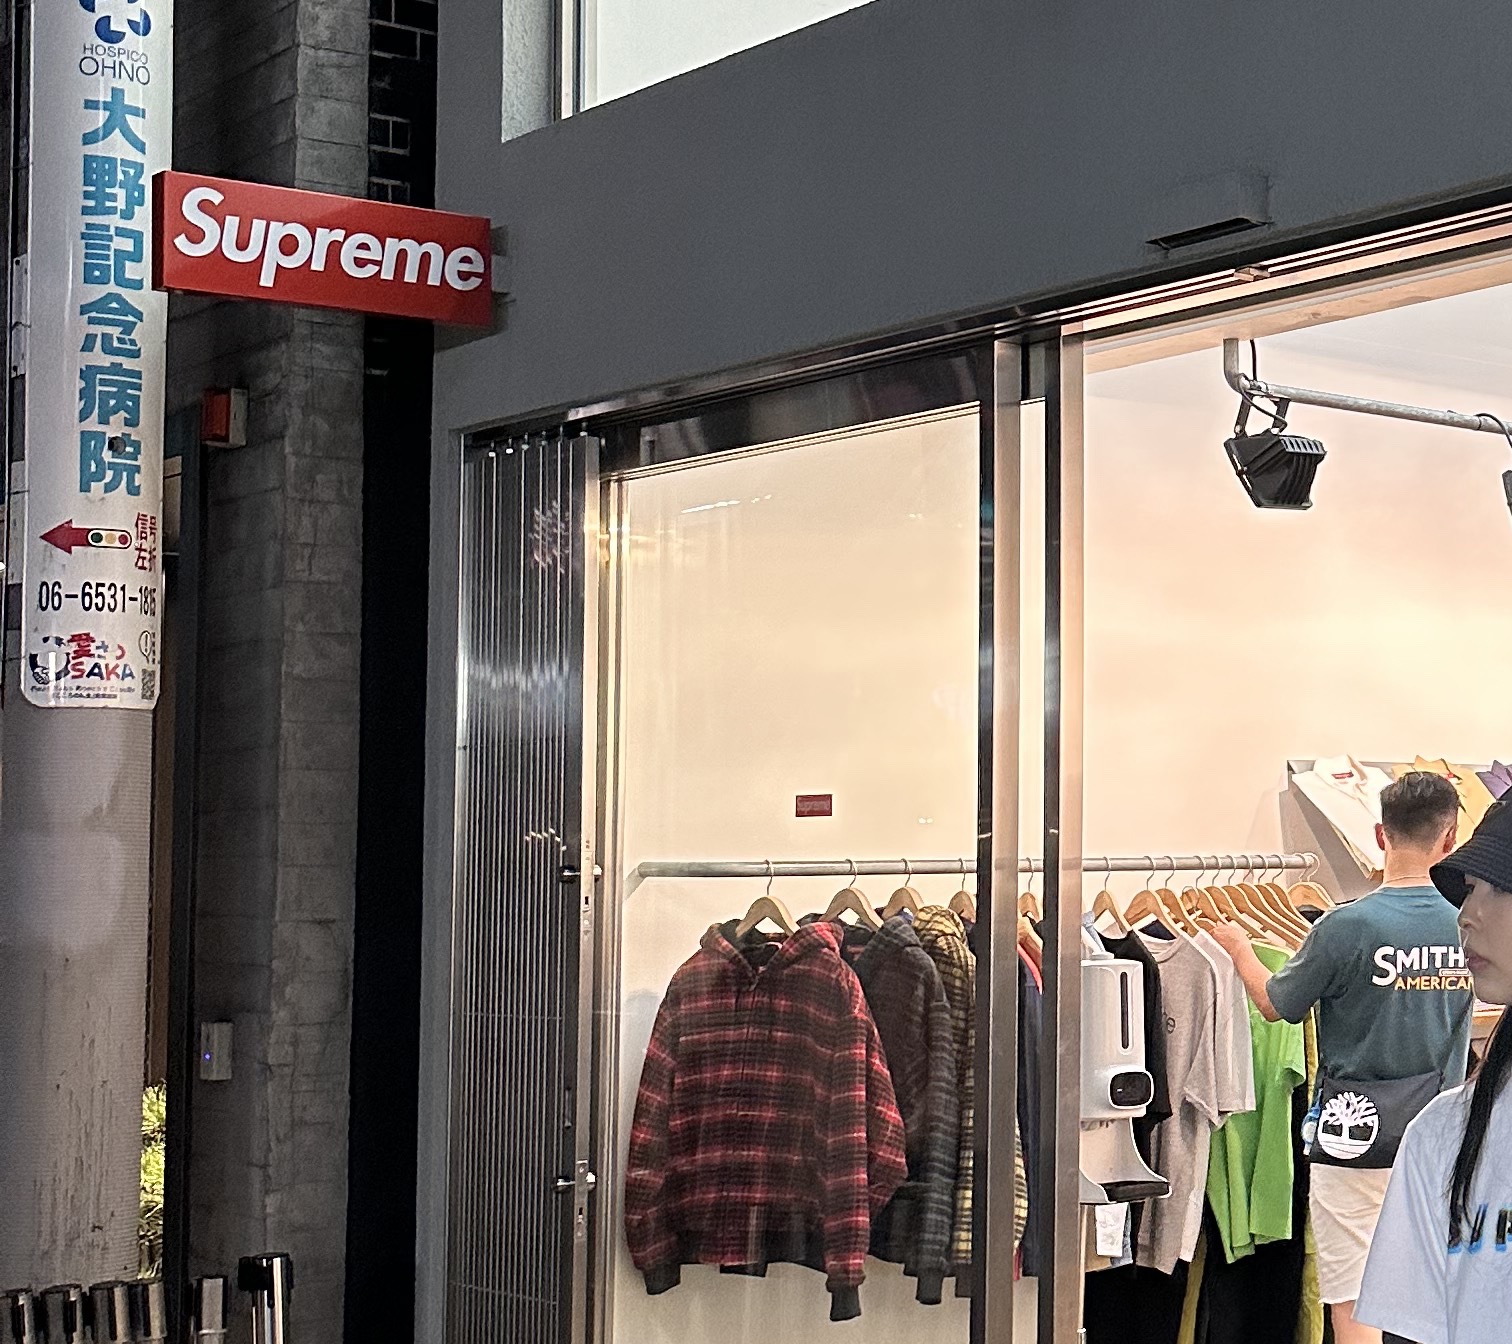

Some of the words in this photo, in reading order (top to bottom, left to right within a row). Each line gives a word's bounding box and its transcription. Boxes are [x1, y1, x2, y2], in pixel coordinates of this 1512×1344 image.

[79, 56, 151, 86] OHNO
[173, 187, 485, 292] Supreme
[79, 88, 146, 497] 大野記念病院
[1372, 945, 1466, 987] SMITH
